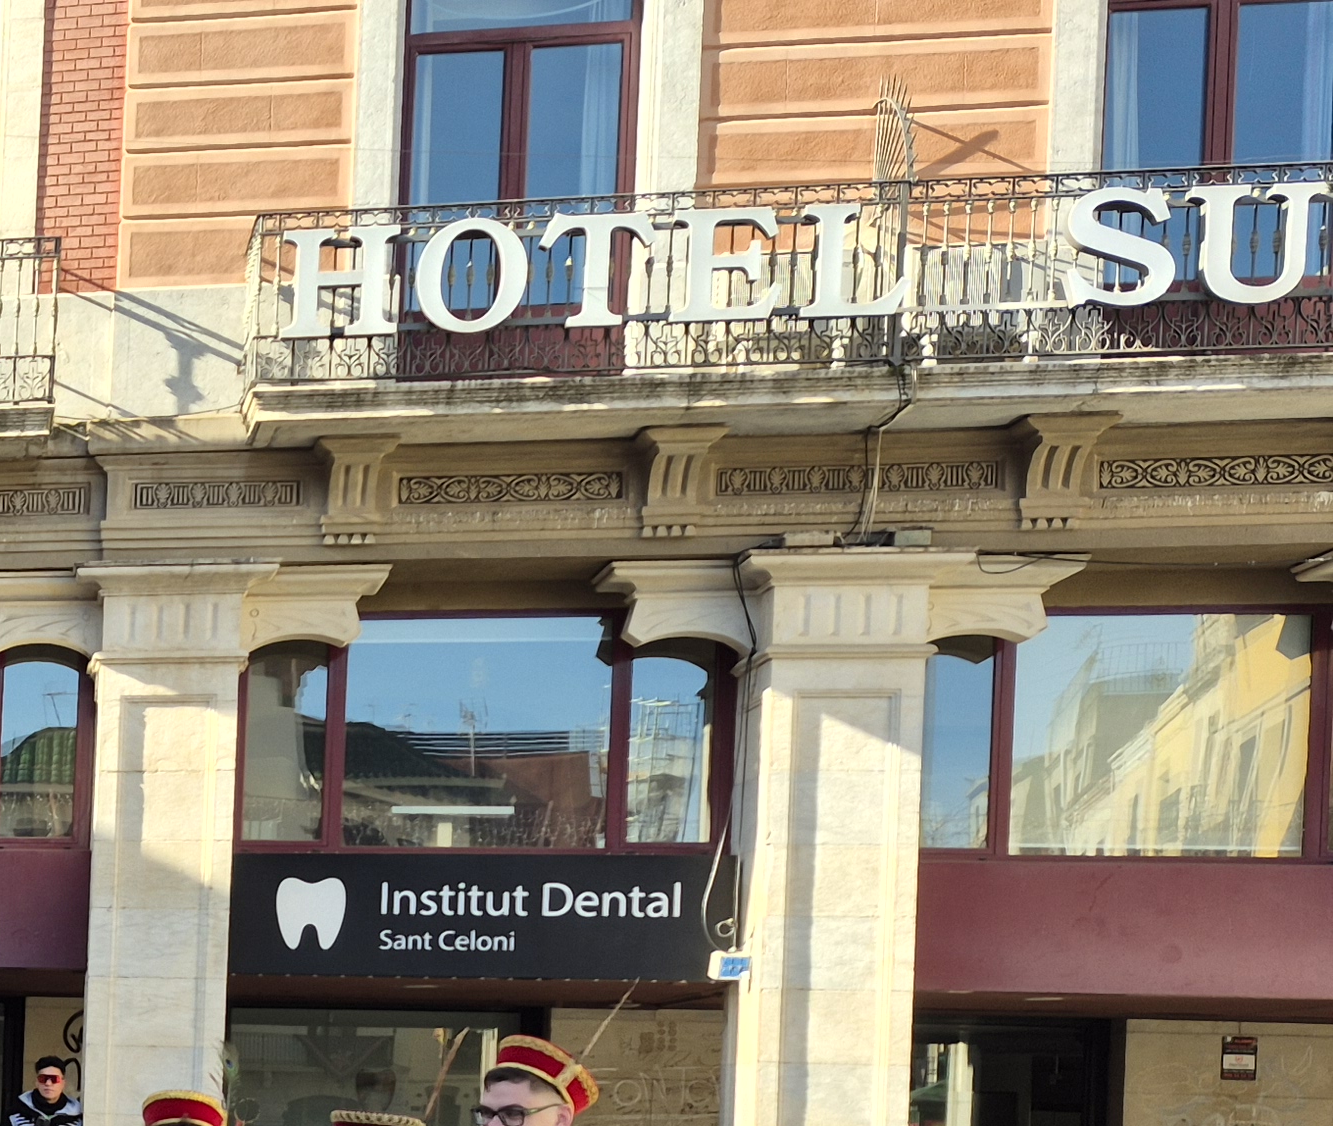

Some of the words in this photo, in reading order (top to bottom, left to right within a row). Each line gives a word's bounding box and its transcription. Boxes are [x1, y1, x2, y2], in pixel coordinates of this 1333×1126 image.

[279, 202, 909, 339] HOTEL
[1062, 182, 1332, 307] SU
[380, 881, 528, 918] Institut
[541, 881, 682, 918] Dental
[379, 929, 432, 952] Sant
[438, 929, 516, 952] Celoni
